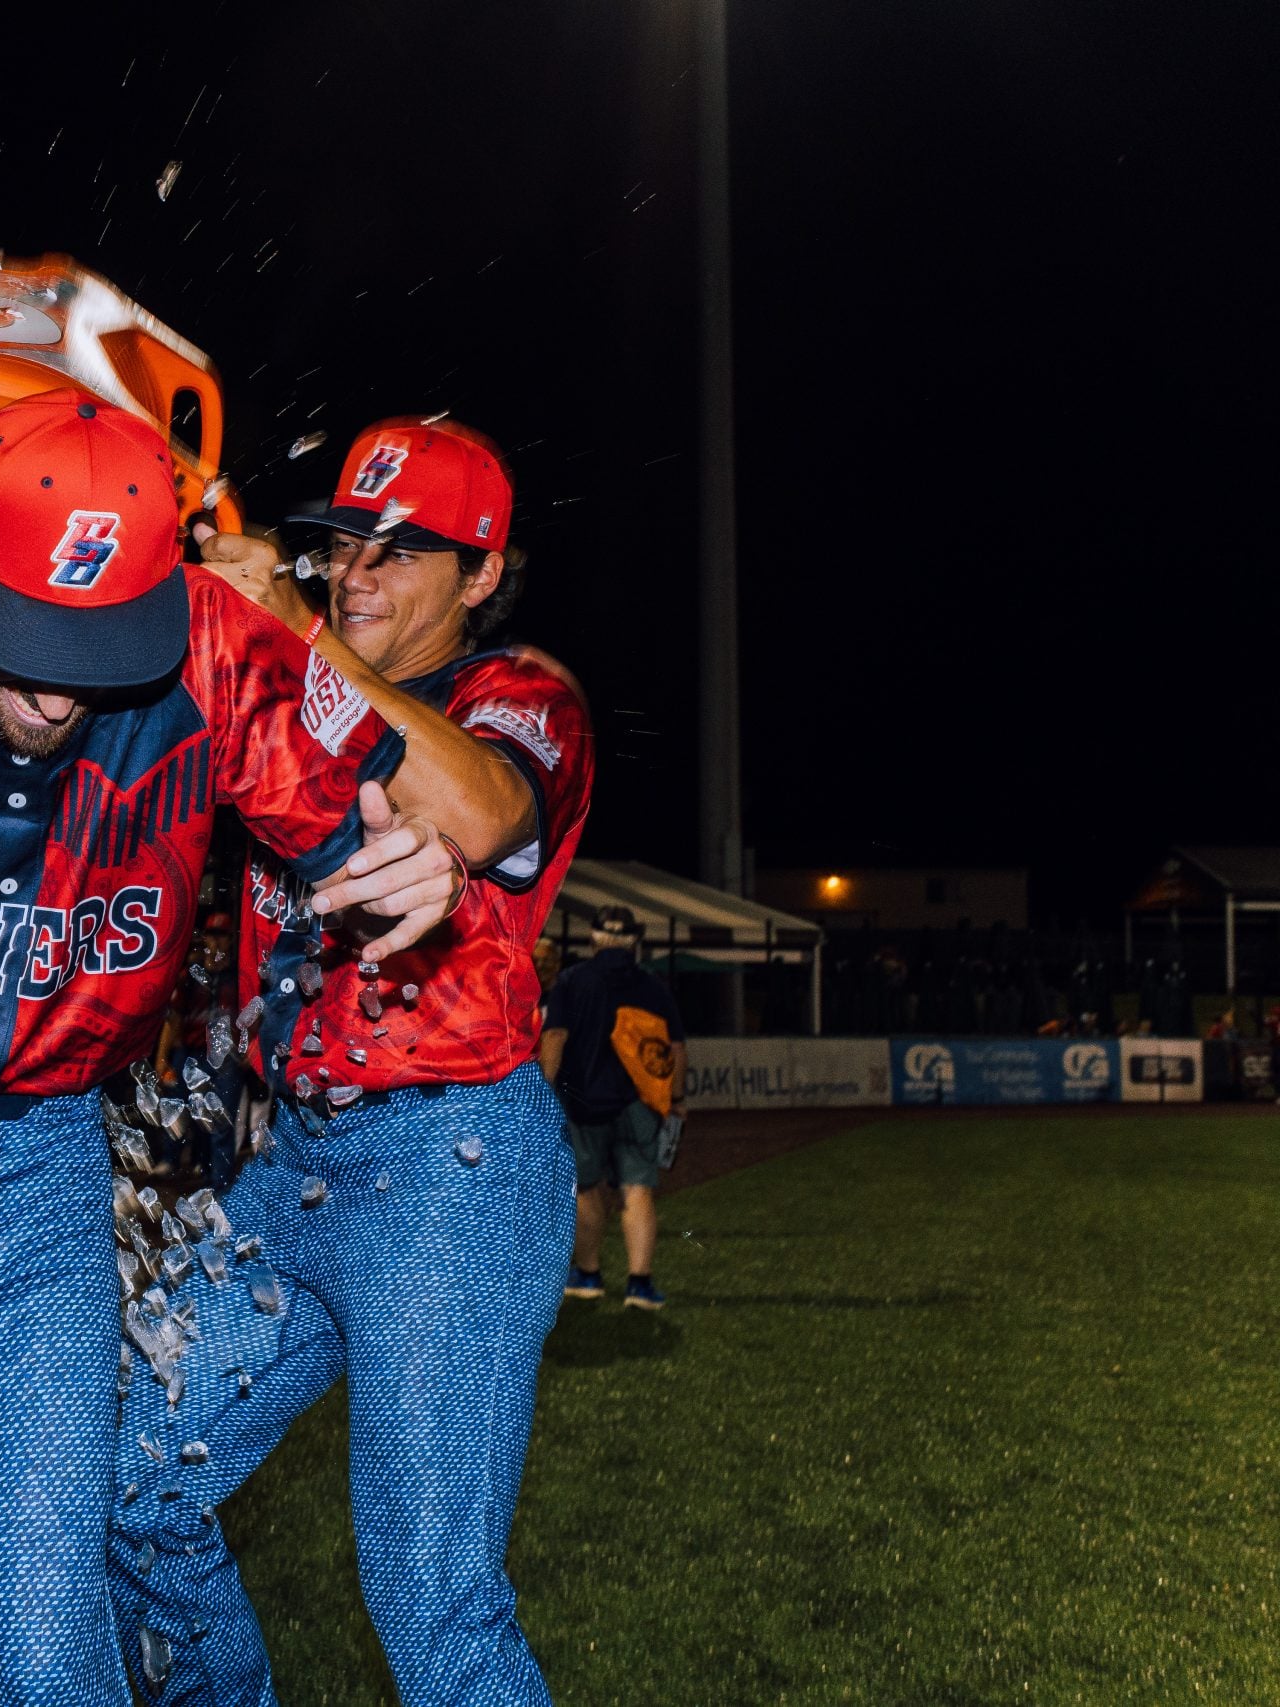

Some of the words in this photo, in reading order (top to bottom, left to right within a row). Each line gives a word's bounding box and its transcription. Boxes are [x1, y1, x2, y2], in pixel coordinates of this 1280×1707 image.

[303, 669, 350, 734] USP
[330, 705, 363, 742] mortgage
[685, 1066, 730, 1097] OAK
[738, 1065, 790, 1096] HILL
